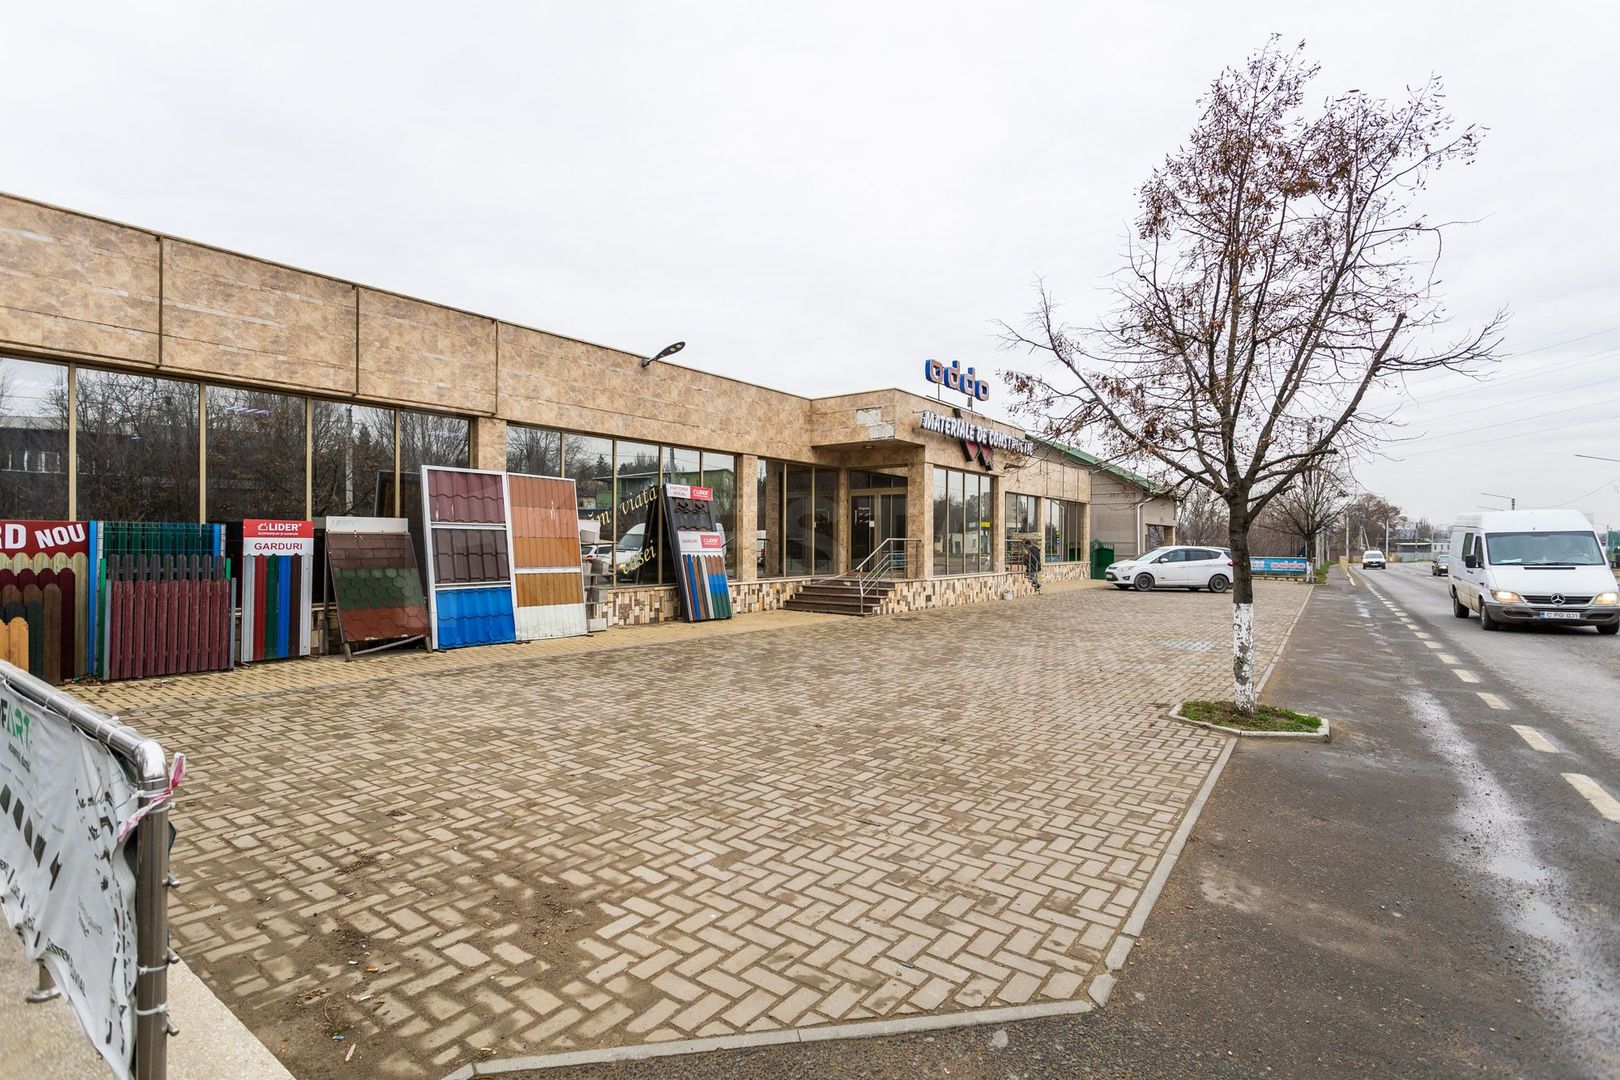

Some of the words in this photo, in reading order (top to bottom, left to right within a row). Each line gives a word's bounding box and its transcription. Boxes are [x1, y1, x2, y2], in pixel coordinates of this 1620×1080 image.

[921, 410, 975, 441] MATERIALE
[976, 425, 988, 445] DE
[269, 523, 298, 531] LIDER
[35, 523, 86, 549] NOU
[254, 542, 303, 550] GARDURI
